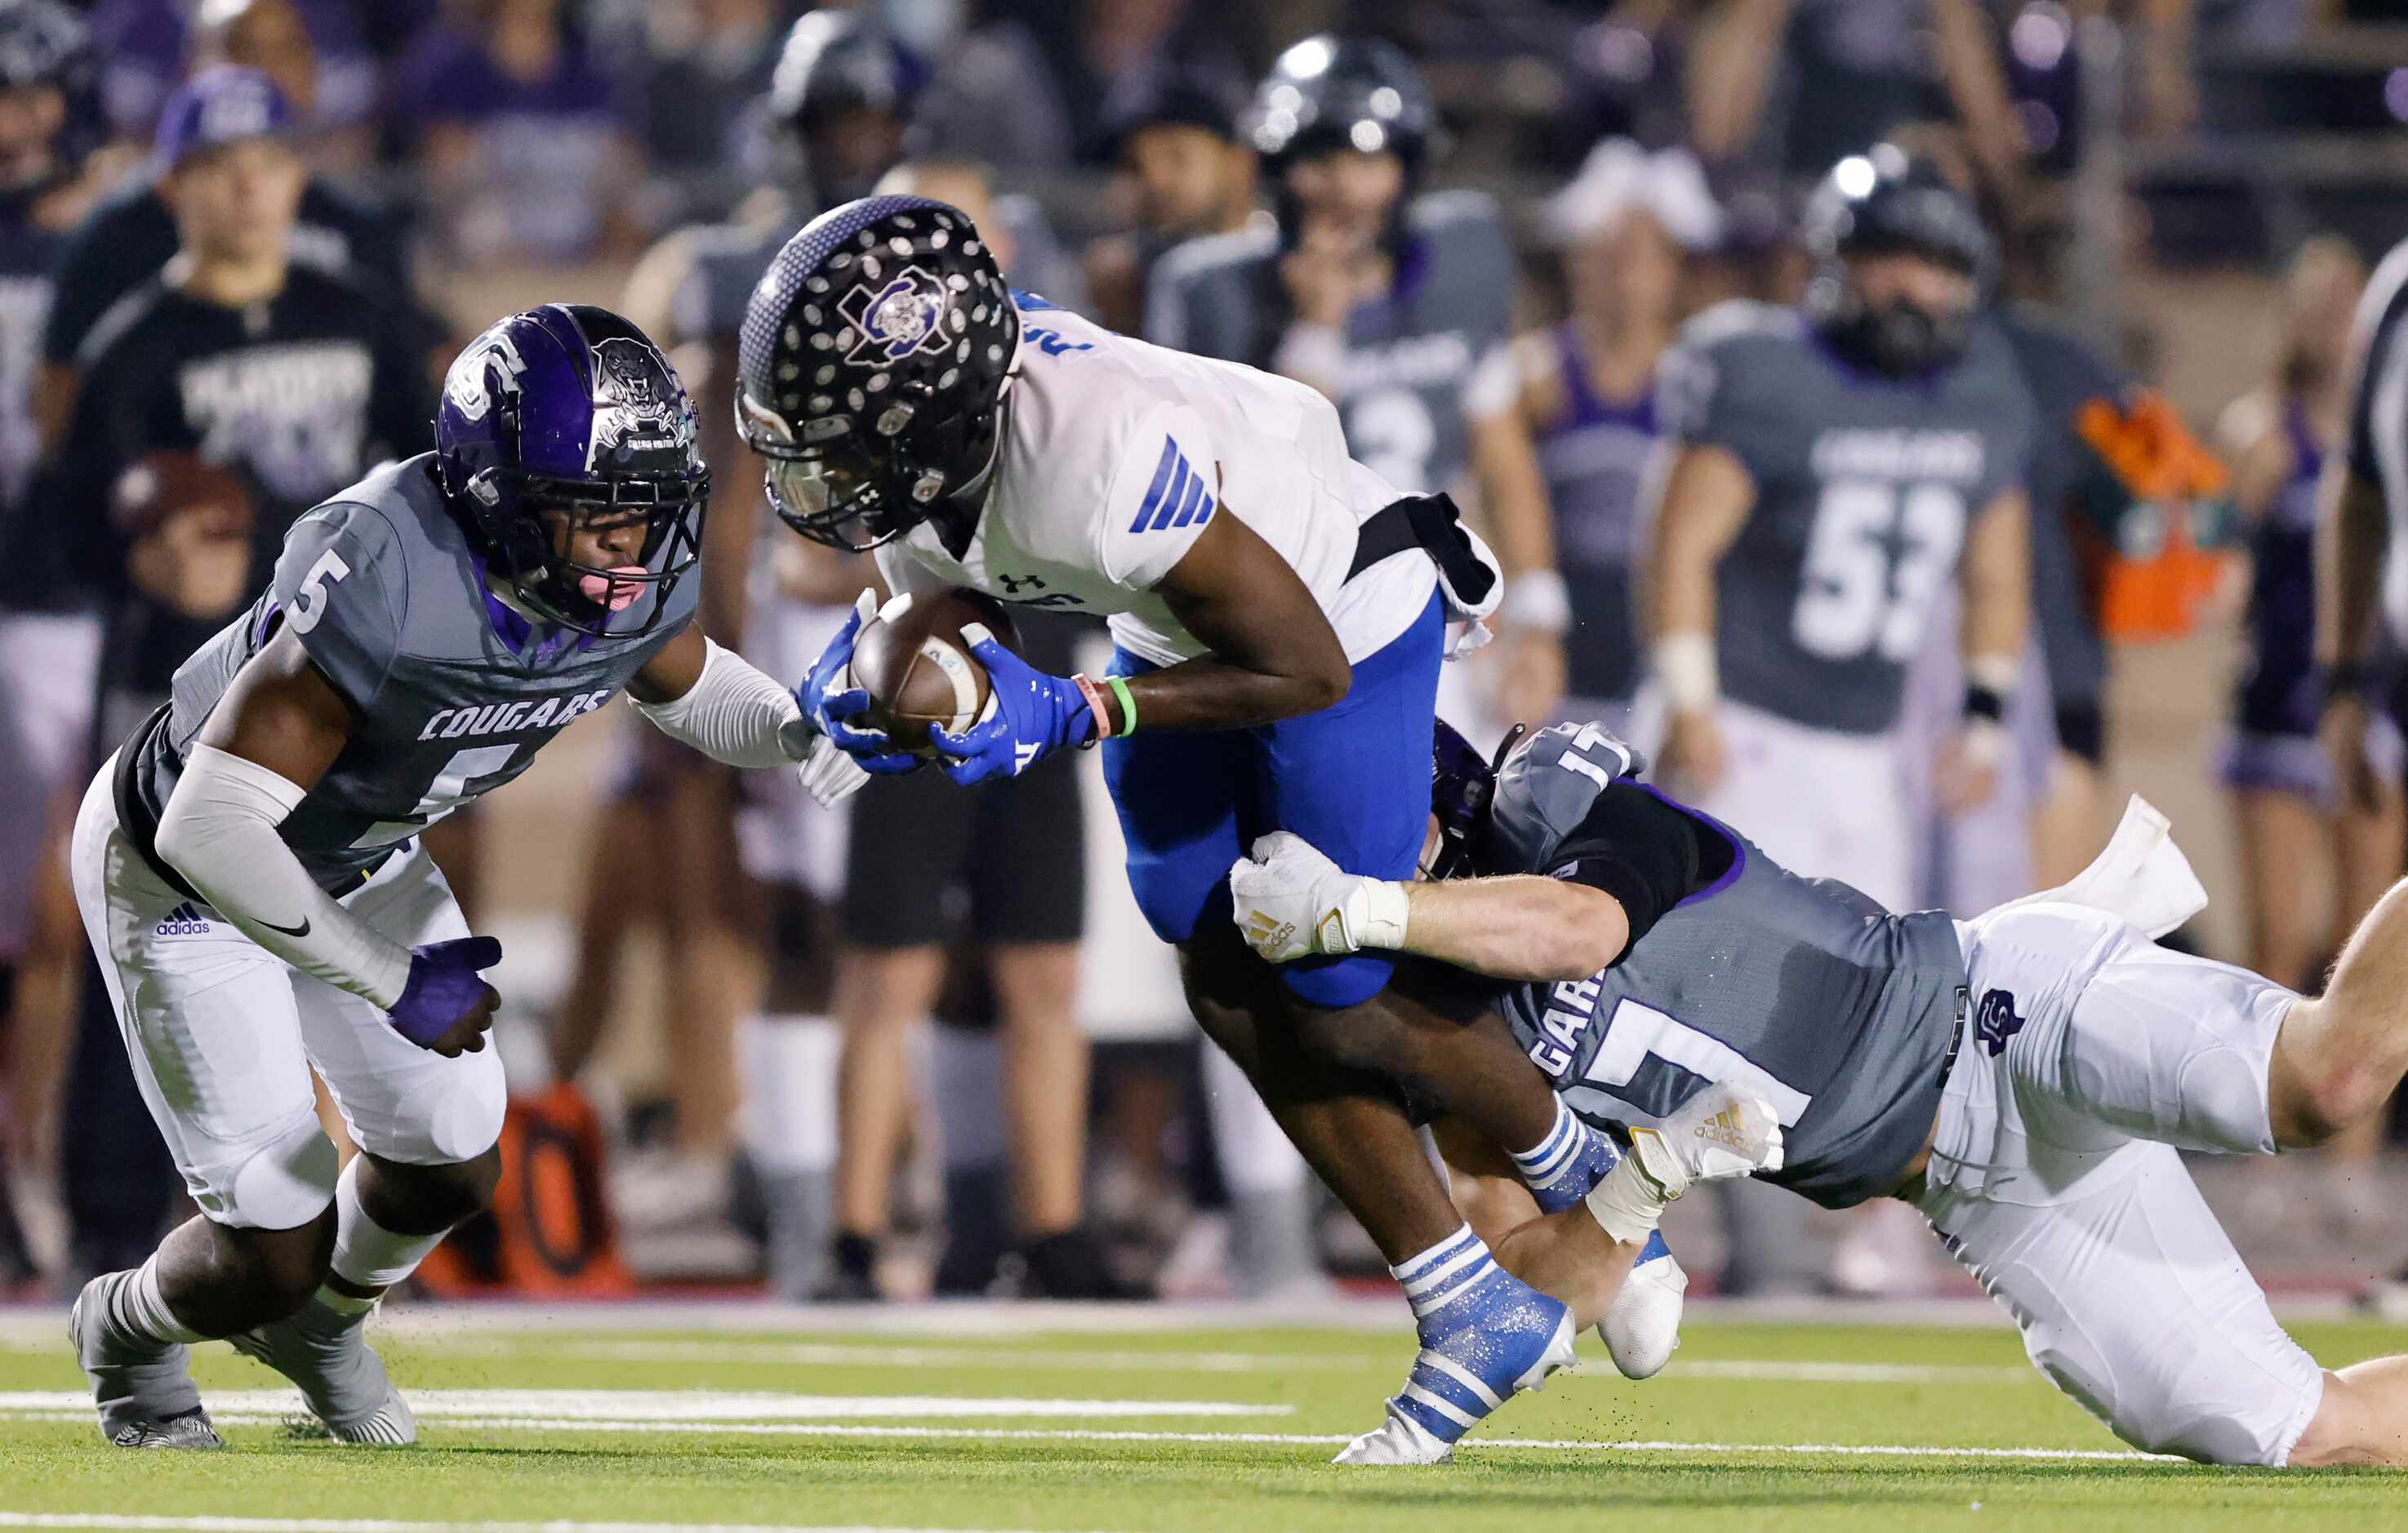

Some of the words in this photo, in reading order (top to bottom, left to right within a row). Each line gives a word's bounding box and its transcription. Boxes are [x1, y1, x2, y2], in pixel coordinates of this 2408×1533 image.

[286, 548, 351, 635] 5
[416, 689, 610, 741] COUGARS
[156, 921, 210, 935] adidas
